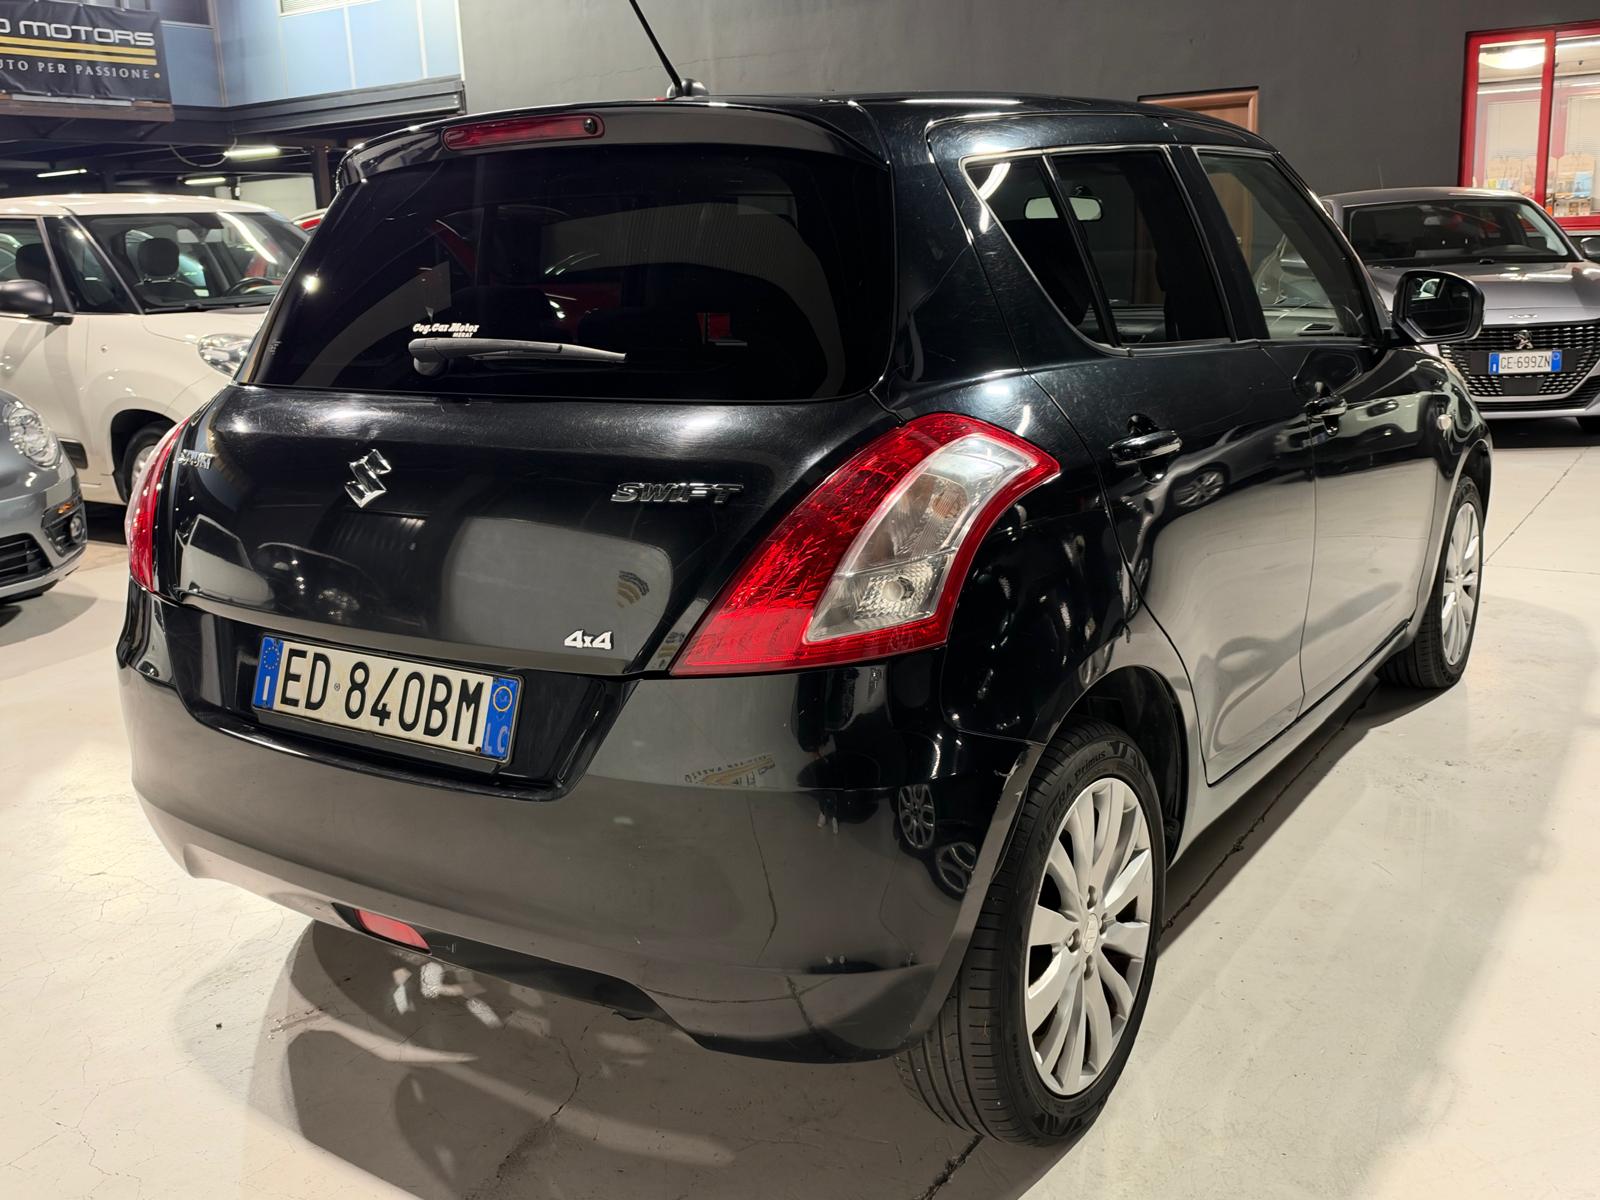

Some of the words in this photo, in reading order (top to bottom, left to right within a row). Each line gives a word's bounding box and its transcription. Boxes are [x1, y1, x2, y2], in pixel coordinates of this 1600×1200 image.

[19, 20, 155, 47] MOTORS
[38, 61, 67, 74] PER
[75, 65, 150, 80] PASSIONE
[611, 482, 744, 503] SWIFT
[564, 629, 613, 650] 4x4
